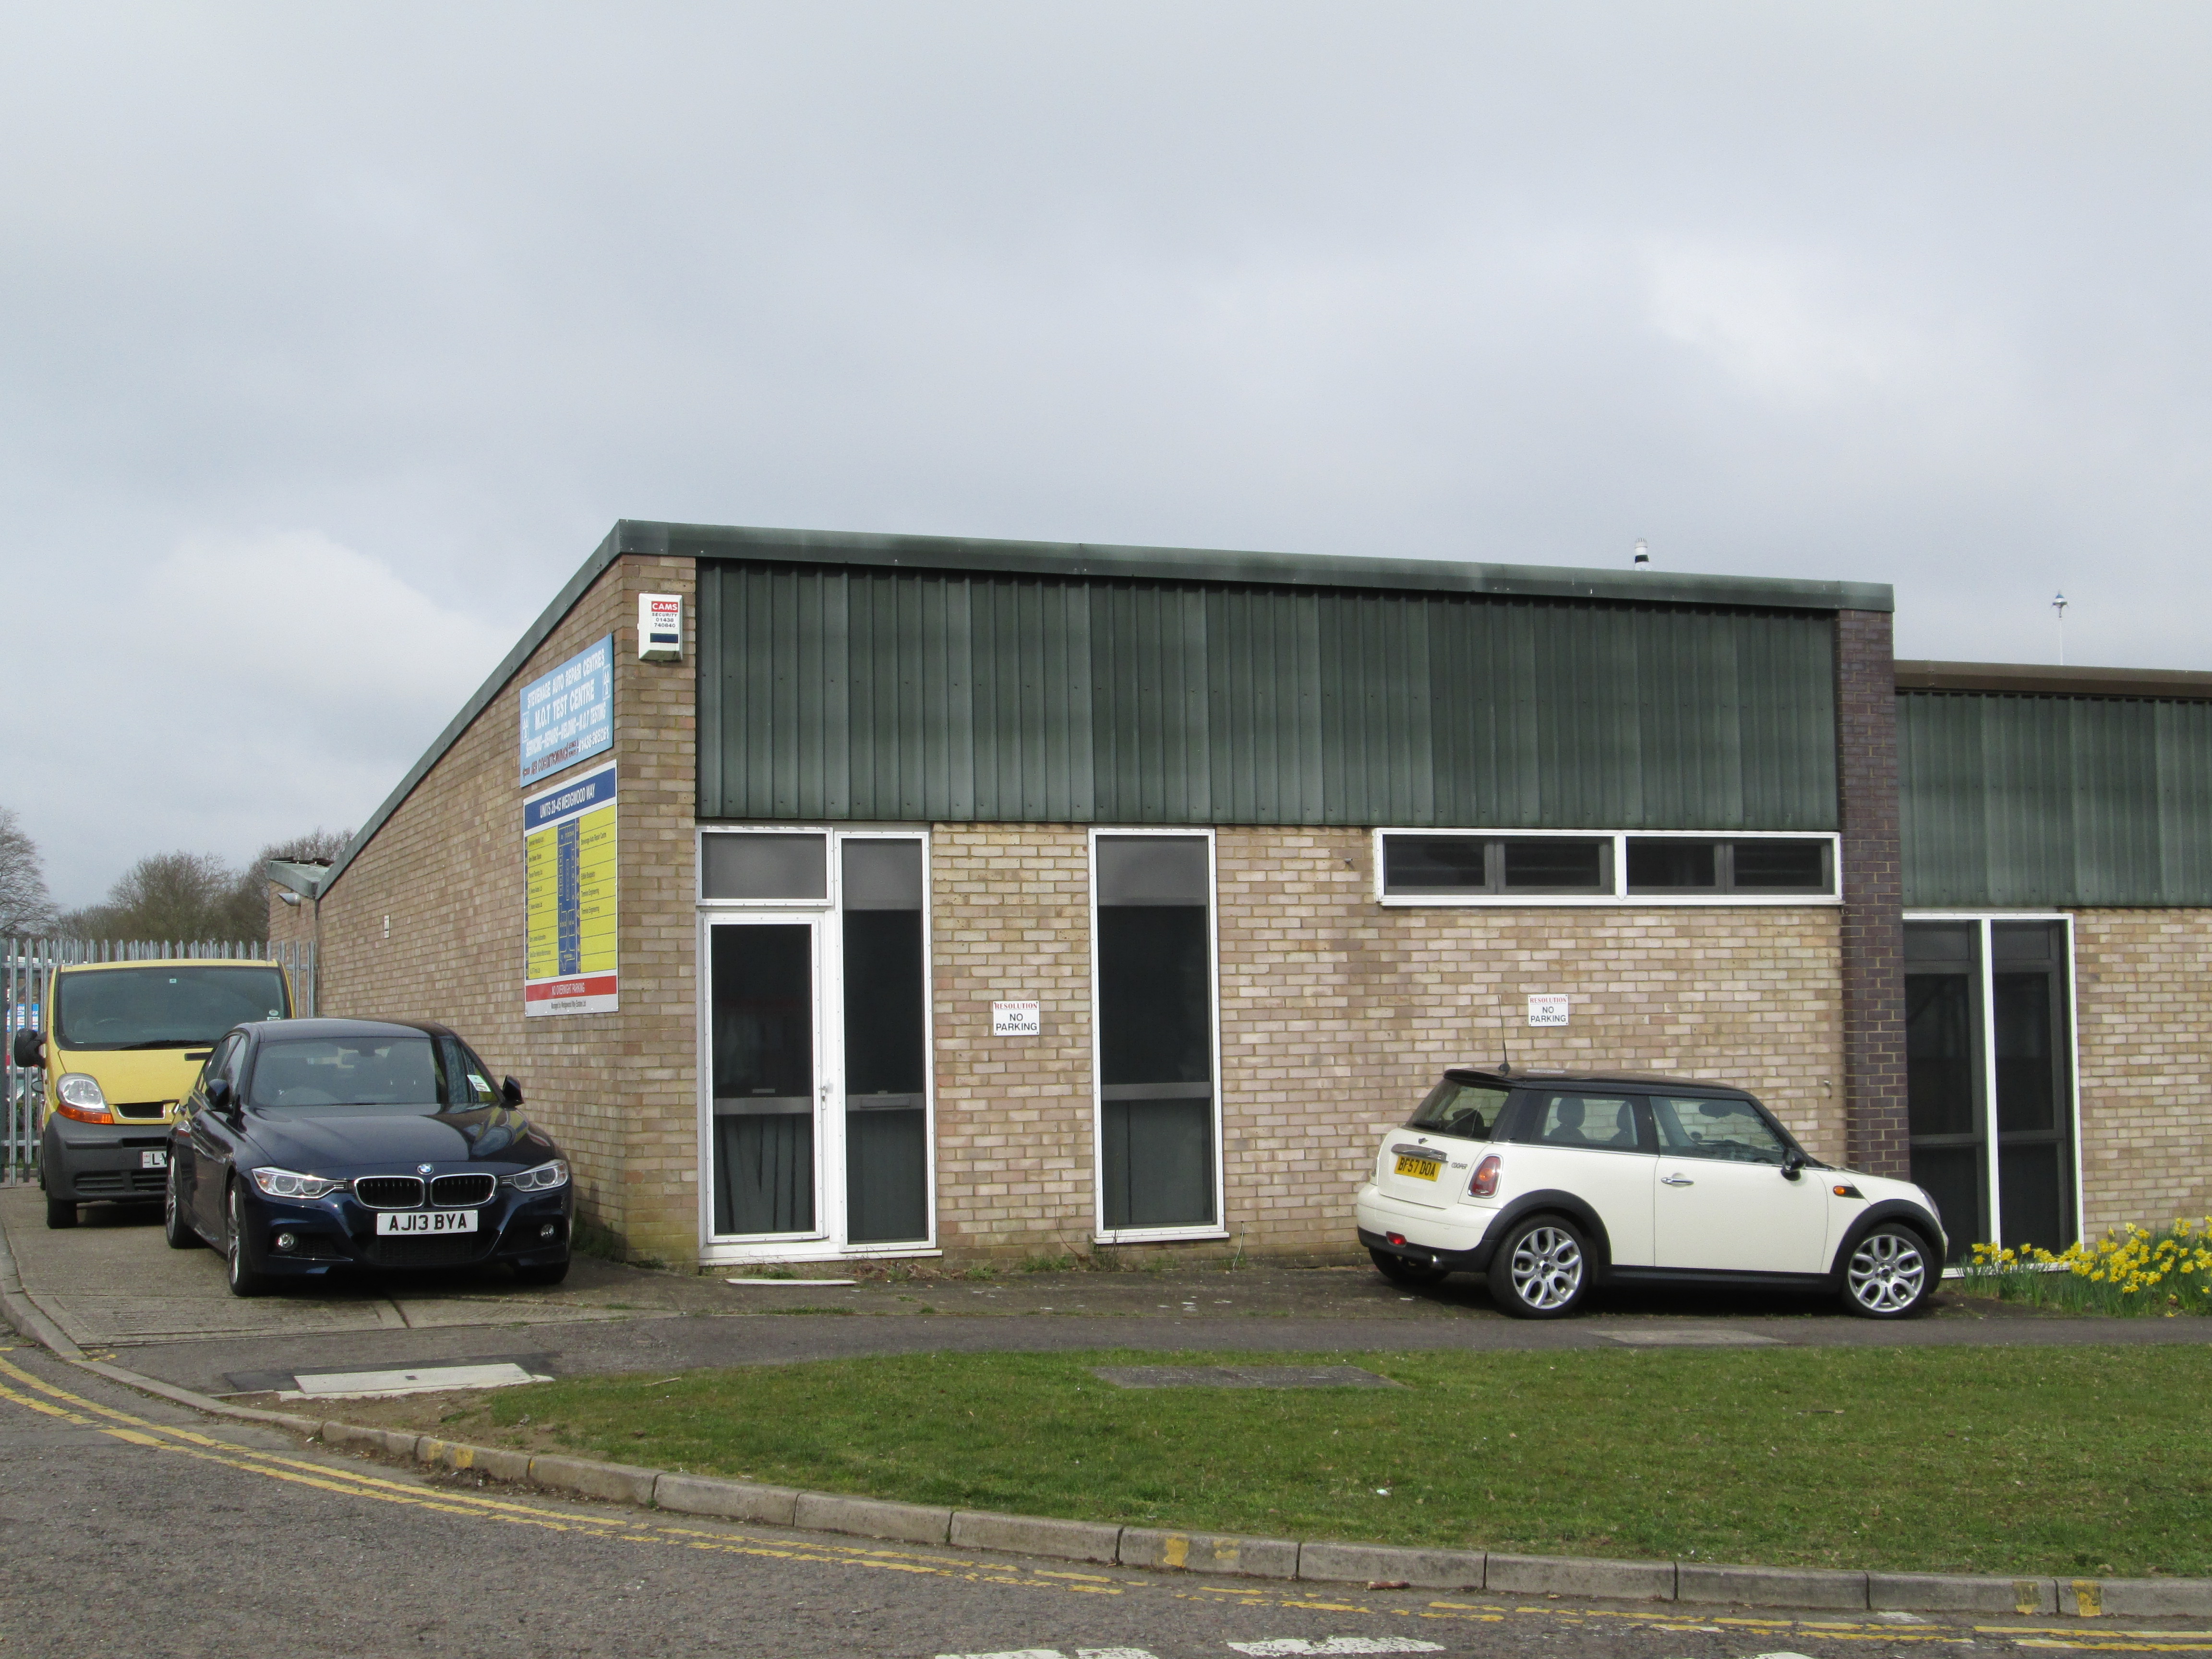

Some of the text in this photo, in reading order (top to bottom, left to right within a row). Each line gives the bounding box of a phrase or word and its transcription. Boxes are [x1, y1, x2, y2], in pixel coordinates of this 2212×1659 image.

[527, 647, 605, 709] STEVENAGE AUTO REPAIR CENTRES
[553, 693, 567, 721] TEST
[569, 677, 595, 712] CENTRE
[540, 801, 551, 819] UNITS
[561, 786, 586, 810] WEDGWOOD
[586, 782, 595, 801] WAY
[996, 1022, 1037, 1031] PARKING
[1398, 1157, 1436, 1177] BF57 DOA
[389, 1214, 467, 1231] AJ13 BYA
